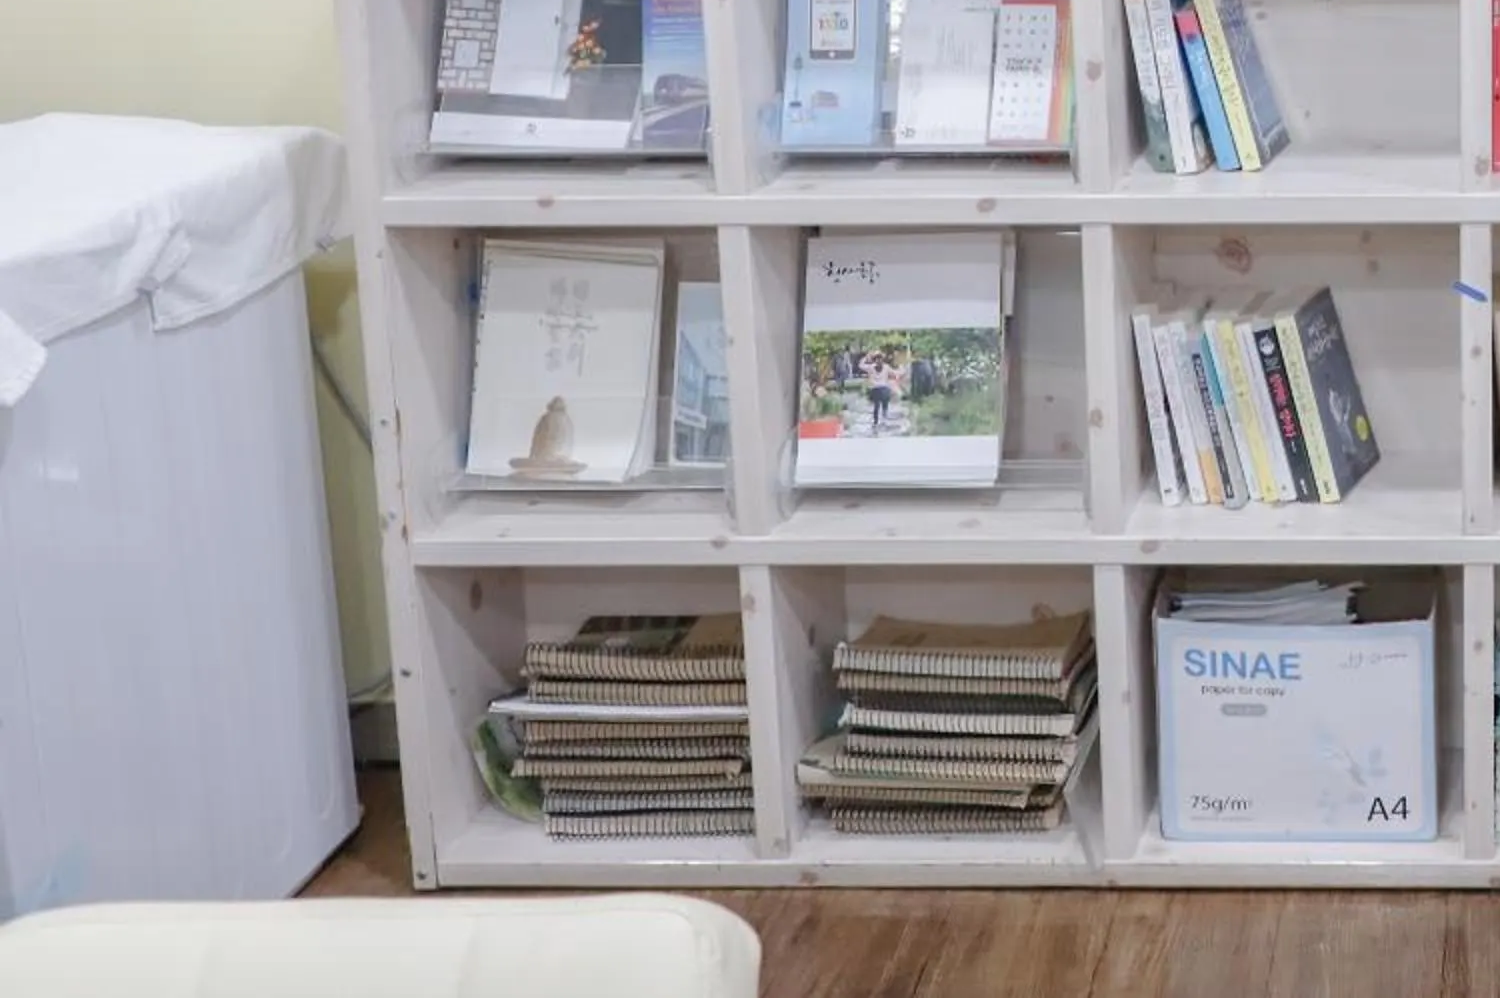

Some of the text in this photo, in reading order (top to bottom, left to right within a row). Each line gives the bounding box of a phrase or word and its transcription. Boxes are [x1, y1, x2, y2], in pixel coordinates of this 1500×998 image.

[1183, 649, 1302, 681] SINAE
[1200, 685, 1236, 696] paper
[1255, 687, 1286, 698] copy
[1367, 796, 1411, 822] A4
